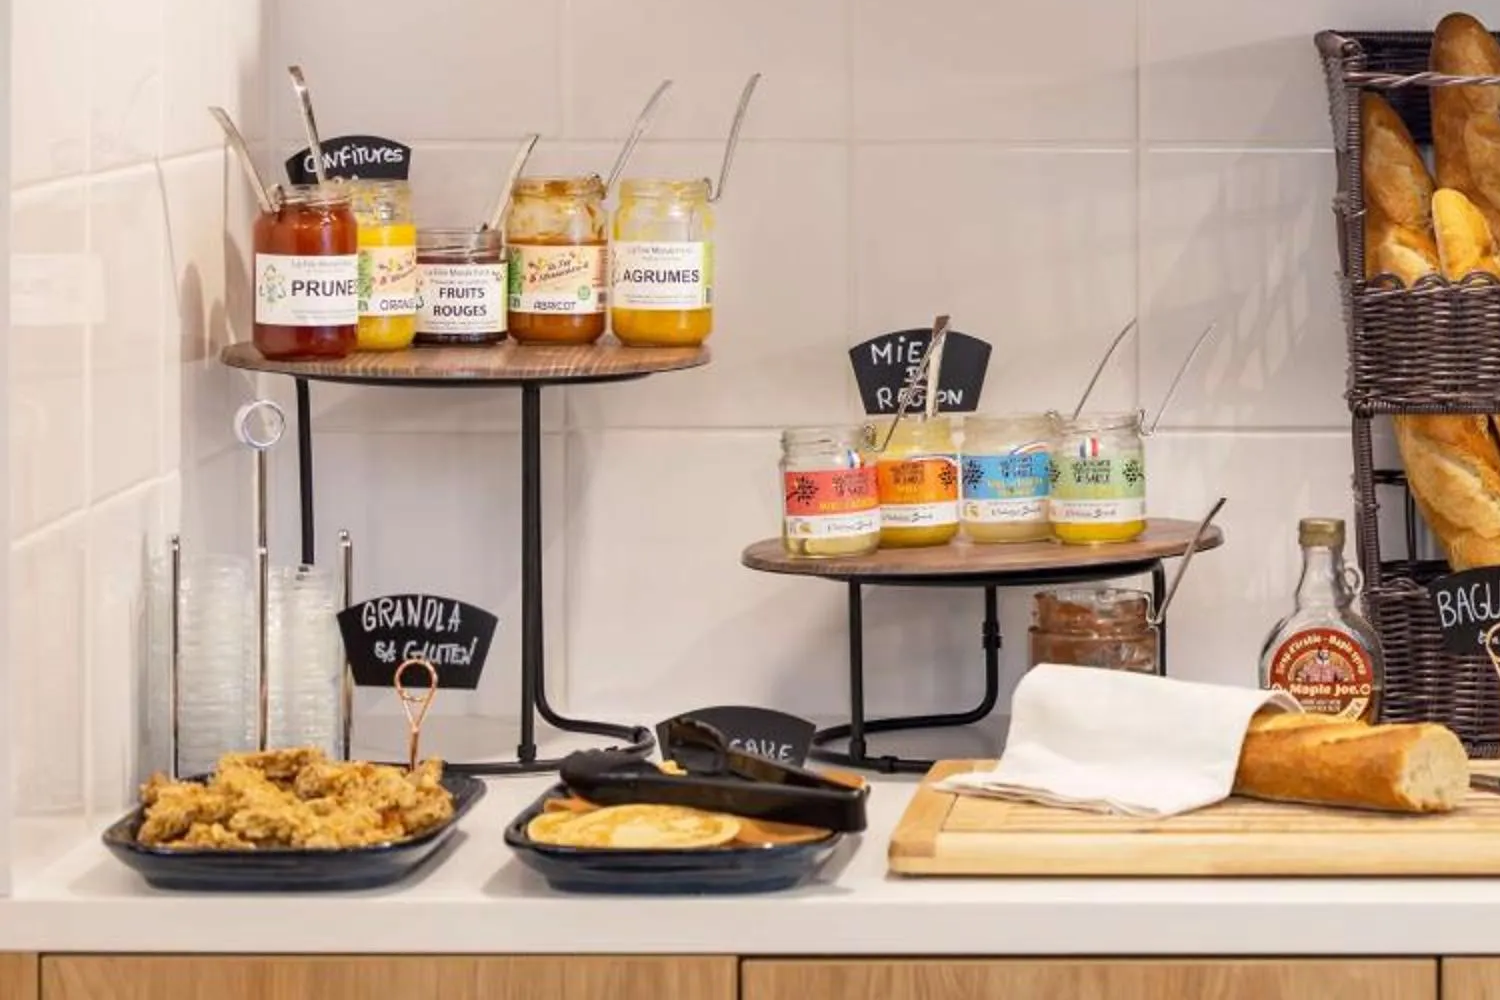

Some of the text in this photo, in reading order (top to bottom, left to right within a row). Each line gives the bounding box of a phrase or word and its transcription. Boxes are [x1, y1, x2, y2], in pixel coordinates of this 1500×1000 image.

[622, 268, 701, 284] AGRUMES
[438, 286, 486, 300] FRUITS
[432, 304, 488, 318] ROUGES
[532, 300, 577, 311] ABRICOT
[361, 594, 462, 633] GRANOLA
[1289, 682, 1332, 697] Maple
